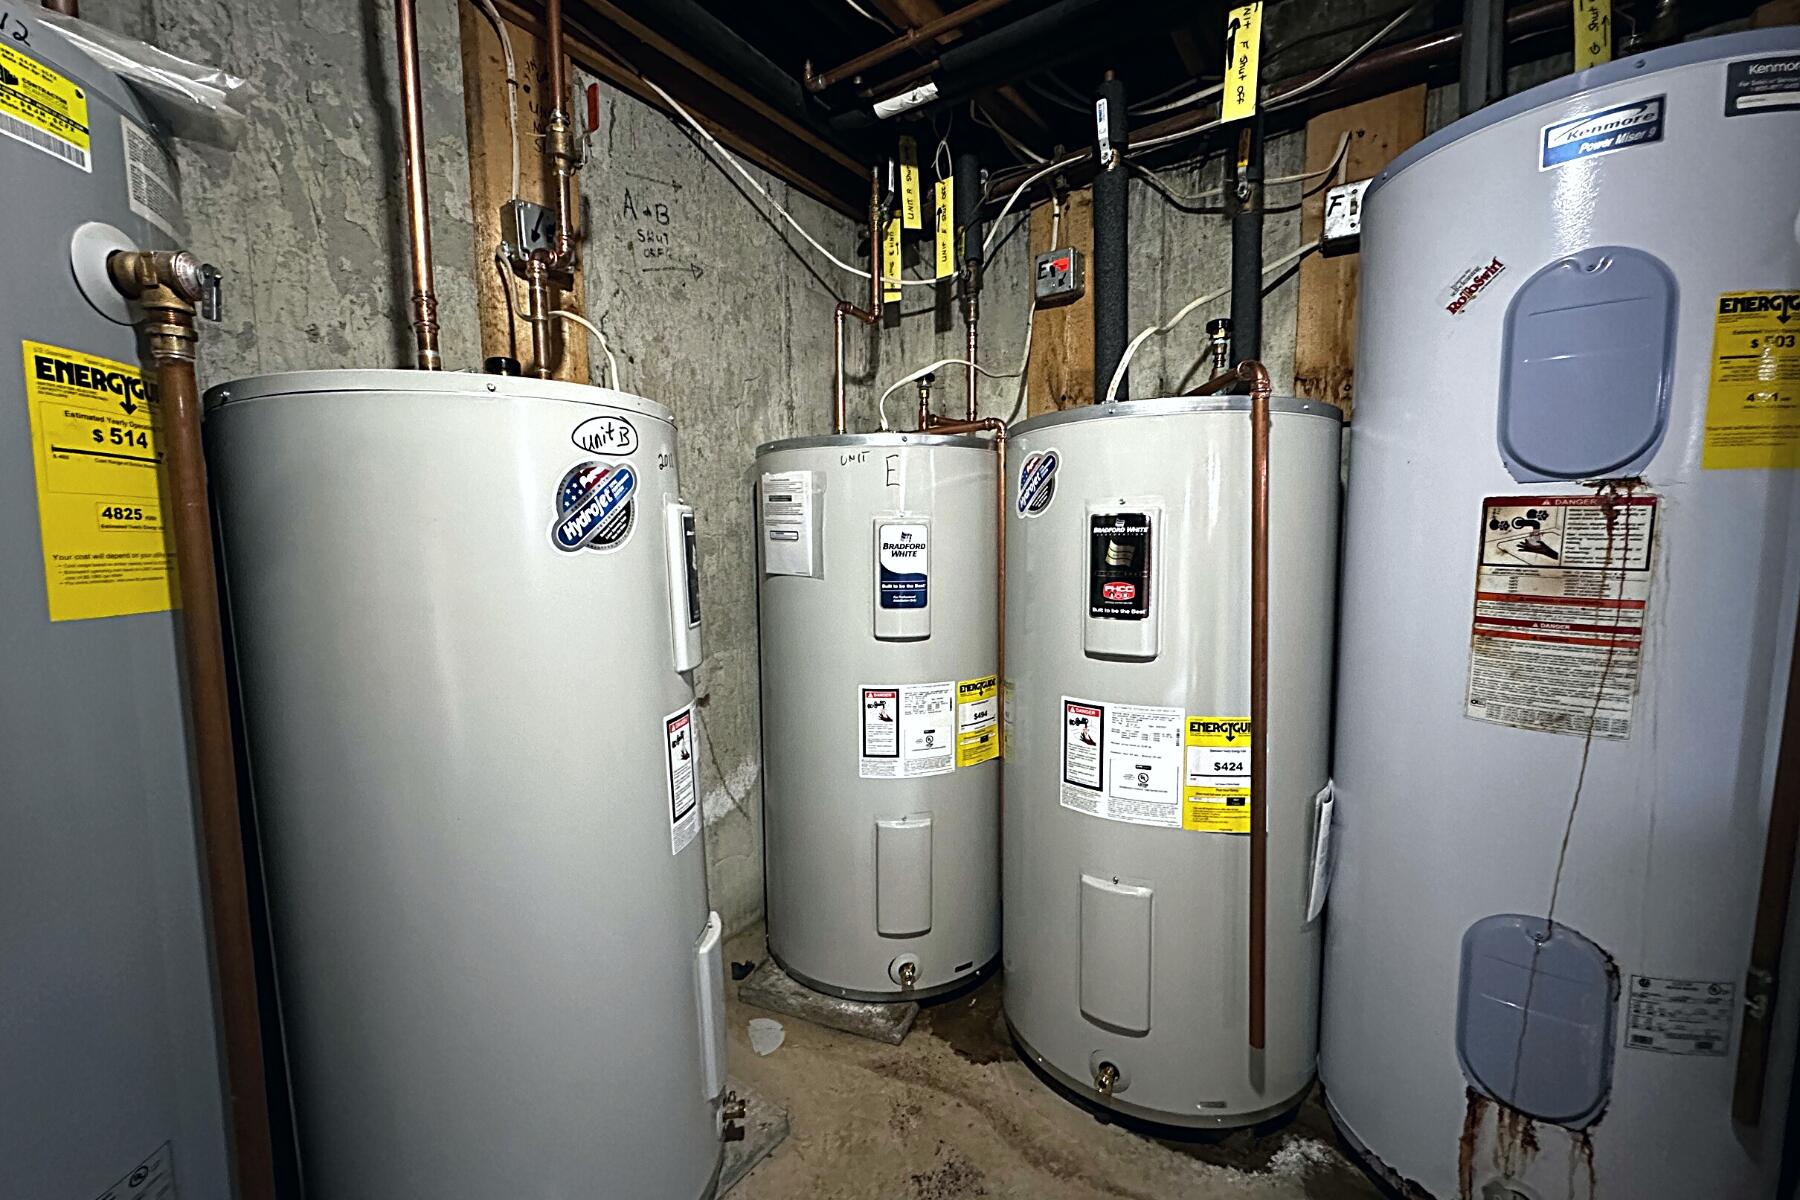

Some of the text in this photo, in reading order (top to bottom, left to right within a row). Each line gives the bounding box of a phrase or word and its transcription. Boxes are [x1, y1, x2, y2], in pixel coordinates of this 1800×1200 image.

[1241, 41, 1249, 49] F
[1588, 43, 1601, 55] G
[1239, 54, 1248, 81] Shut
[1748, 60, 1800, 75] Kenmor
[1566, 111, 1656, 142] Kenmore
[1578, 125, 1658, 155] Power Miser 9
[623, 187, 638, 220] A
[655, 203, 671, 226] B
[1327, 194, 1346, 218] F
[34, 354, 160, 406] ENERGYGU
[110, 427, 148, 449] 514
[616, 426, 631, 448] B
[841, 450, 901, 488] UNIT E
[1555, 496, 1597, 506] DANGER
[101, 507, 143, 521] 4825
[562, 484, 614, 541] Hydrojet
[891, 550, 918, 558] WHITE
[1213, 762, 1244, 772] $424
